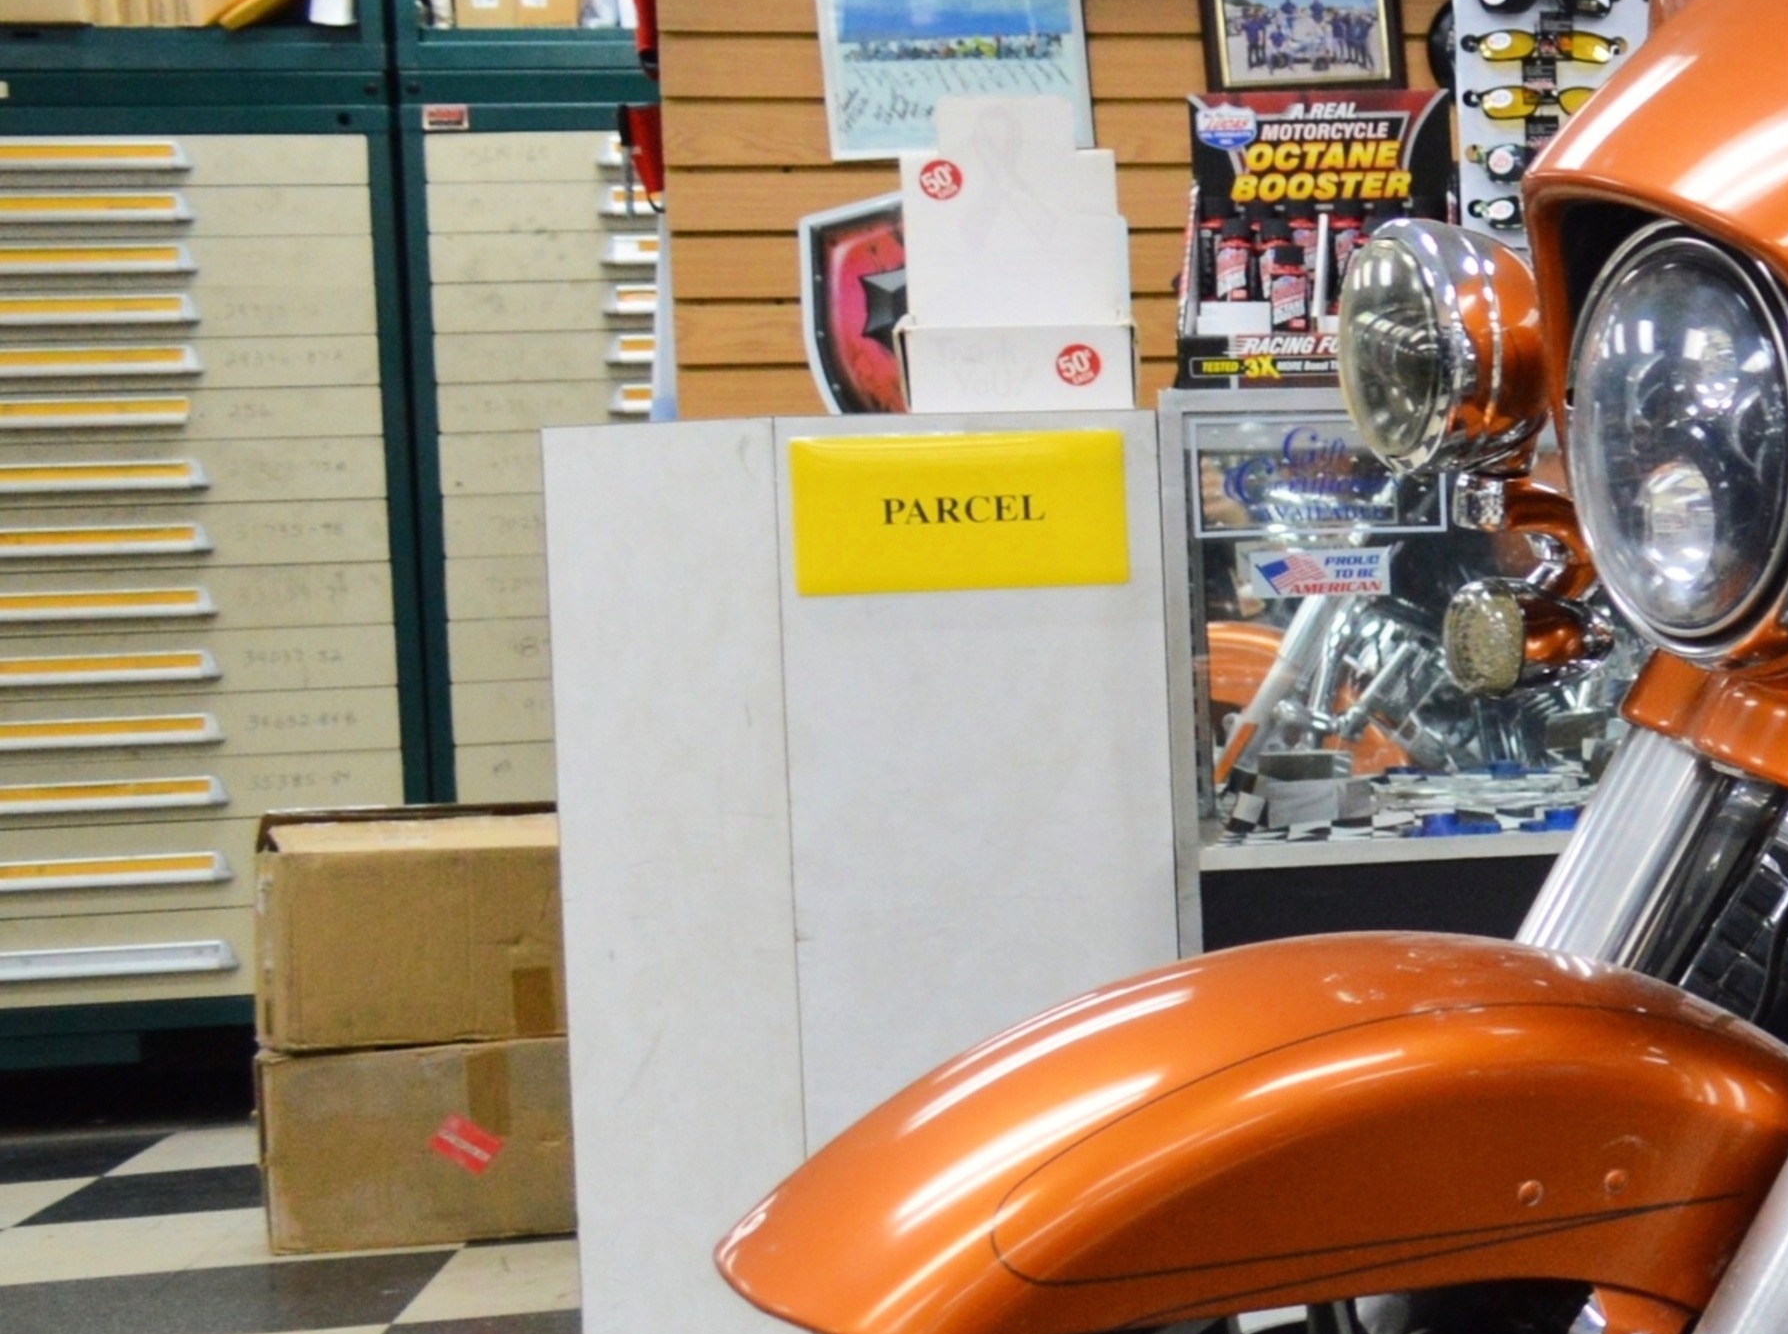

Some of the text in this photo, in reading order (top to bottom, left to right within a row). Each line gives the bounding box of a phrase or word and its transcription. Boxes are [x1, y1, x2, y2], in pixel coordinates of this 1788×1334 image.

[1290, 101, 1358, 120] A REAL
[1260, 121, 1389, 142] MOTORCYCLE
[1246, 141, 1401, 172] OCTANE
[1230, 170, 1413, 202] BOOSTER
[1242, 337, 1316, 355] RACING
[1202, 360, 1240, 372] TESTED
[1244, 355, 1282, 379] 3X
[1282, 425, 1347, 464] Gift
[882, 494, 1045, 525] PARCEL
[1324, 554, 1380, 566] PROUD
[1334, 568, 1356, 578] TO
[1290, 580, 1382, 595] AMERICAN
